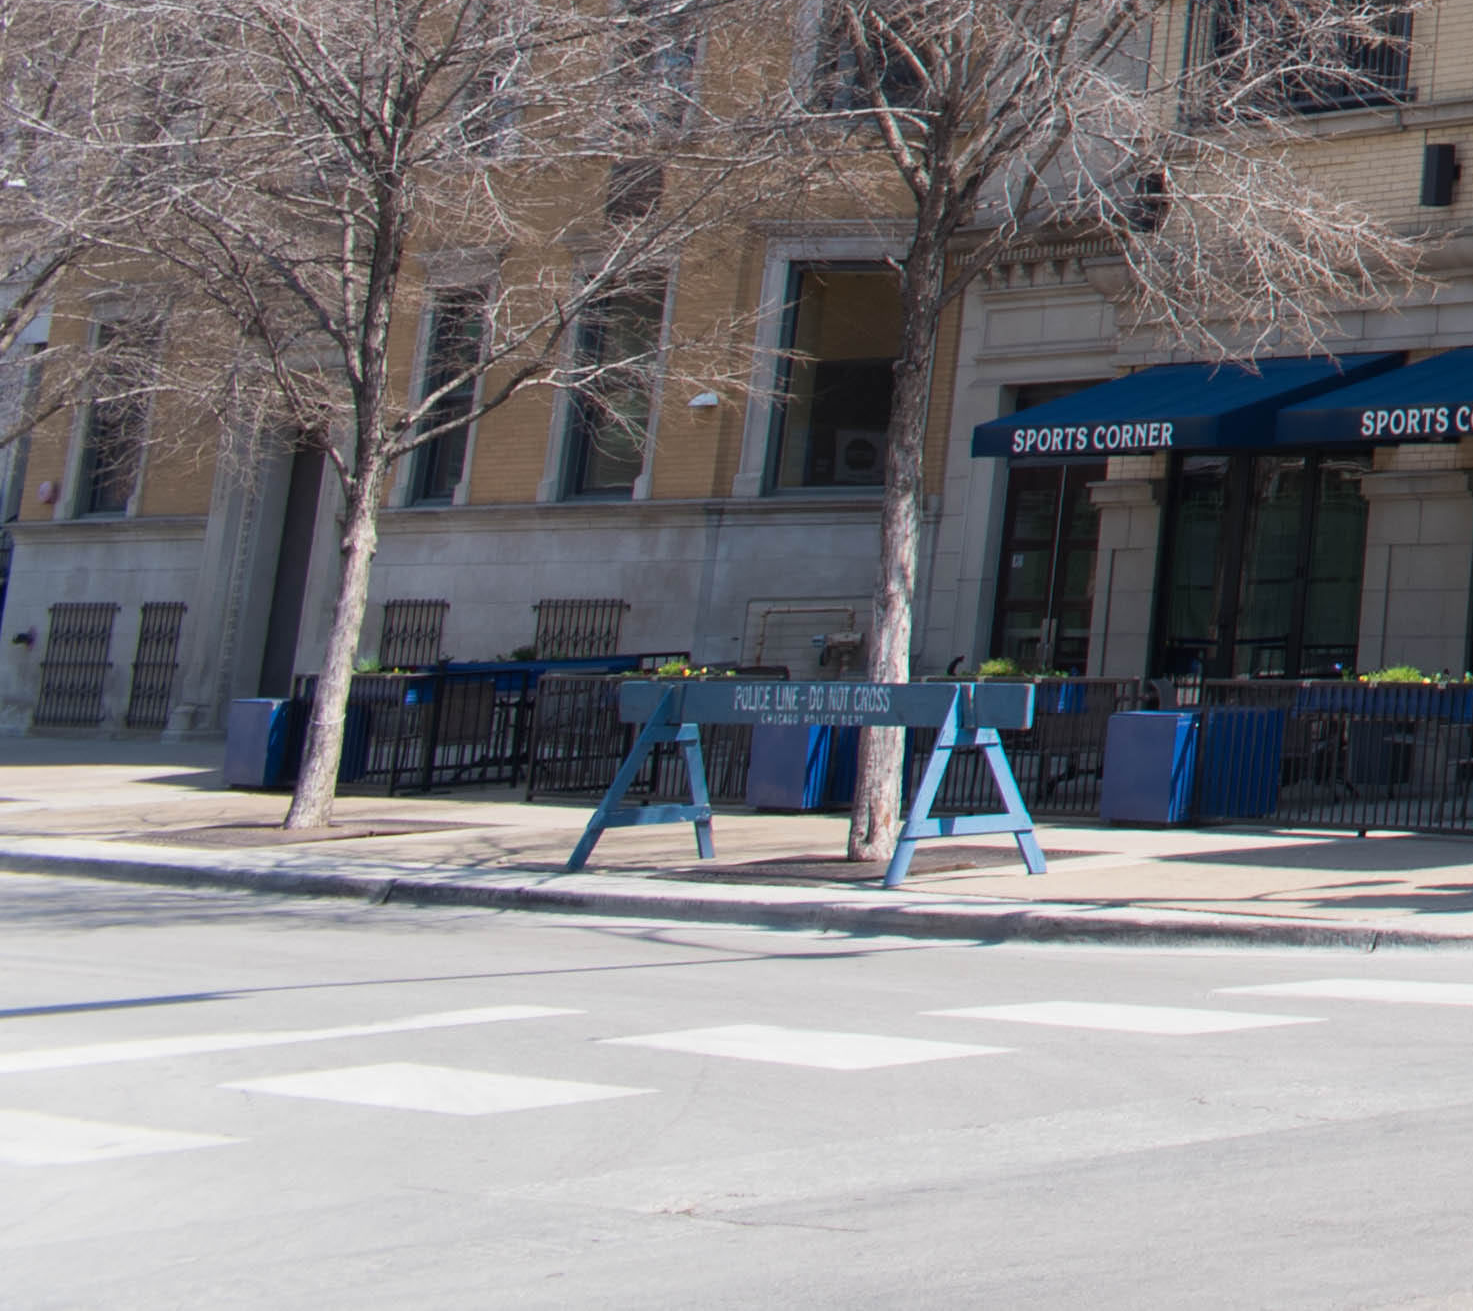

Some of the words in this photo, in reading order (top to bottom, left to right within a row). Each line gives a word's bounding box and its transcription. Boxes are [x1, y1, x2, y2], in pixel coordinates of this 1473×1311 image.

[1361, 407, 1449, 436] SPORTS
[1012, 426, 1088, 453] SPORTS
[1093, 421, 1174, 449] CORNER
[734, 685, 771, 711] POLICE
[775, 686, 799, 711] LINE
[808, 685, 824, 711] DO
[828, 685, 850, 712] NOT
[853, 686, 891, 713] CROSS
[760, 713, 799, 725] CHICAGO
[803, 714, 836, 725] POLICE
